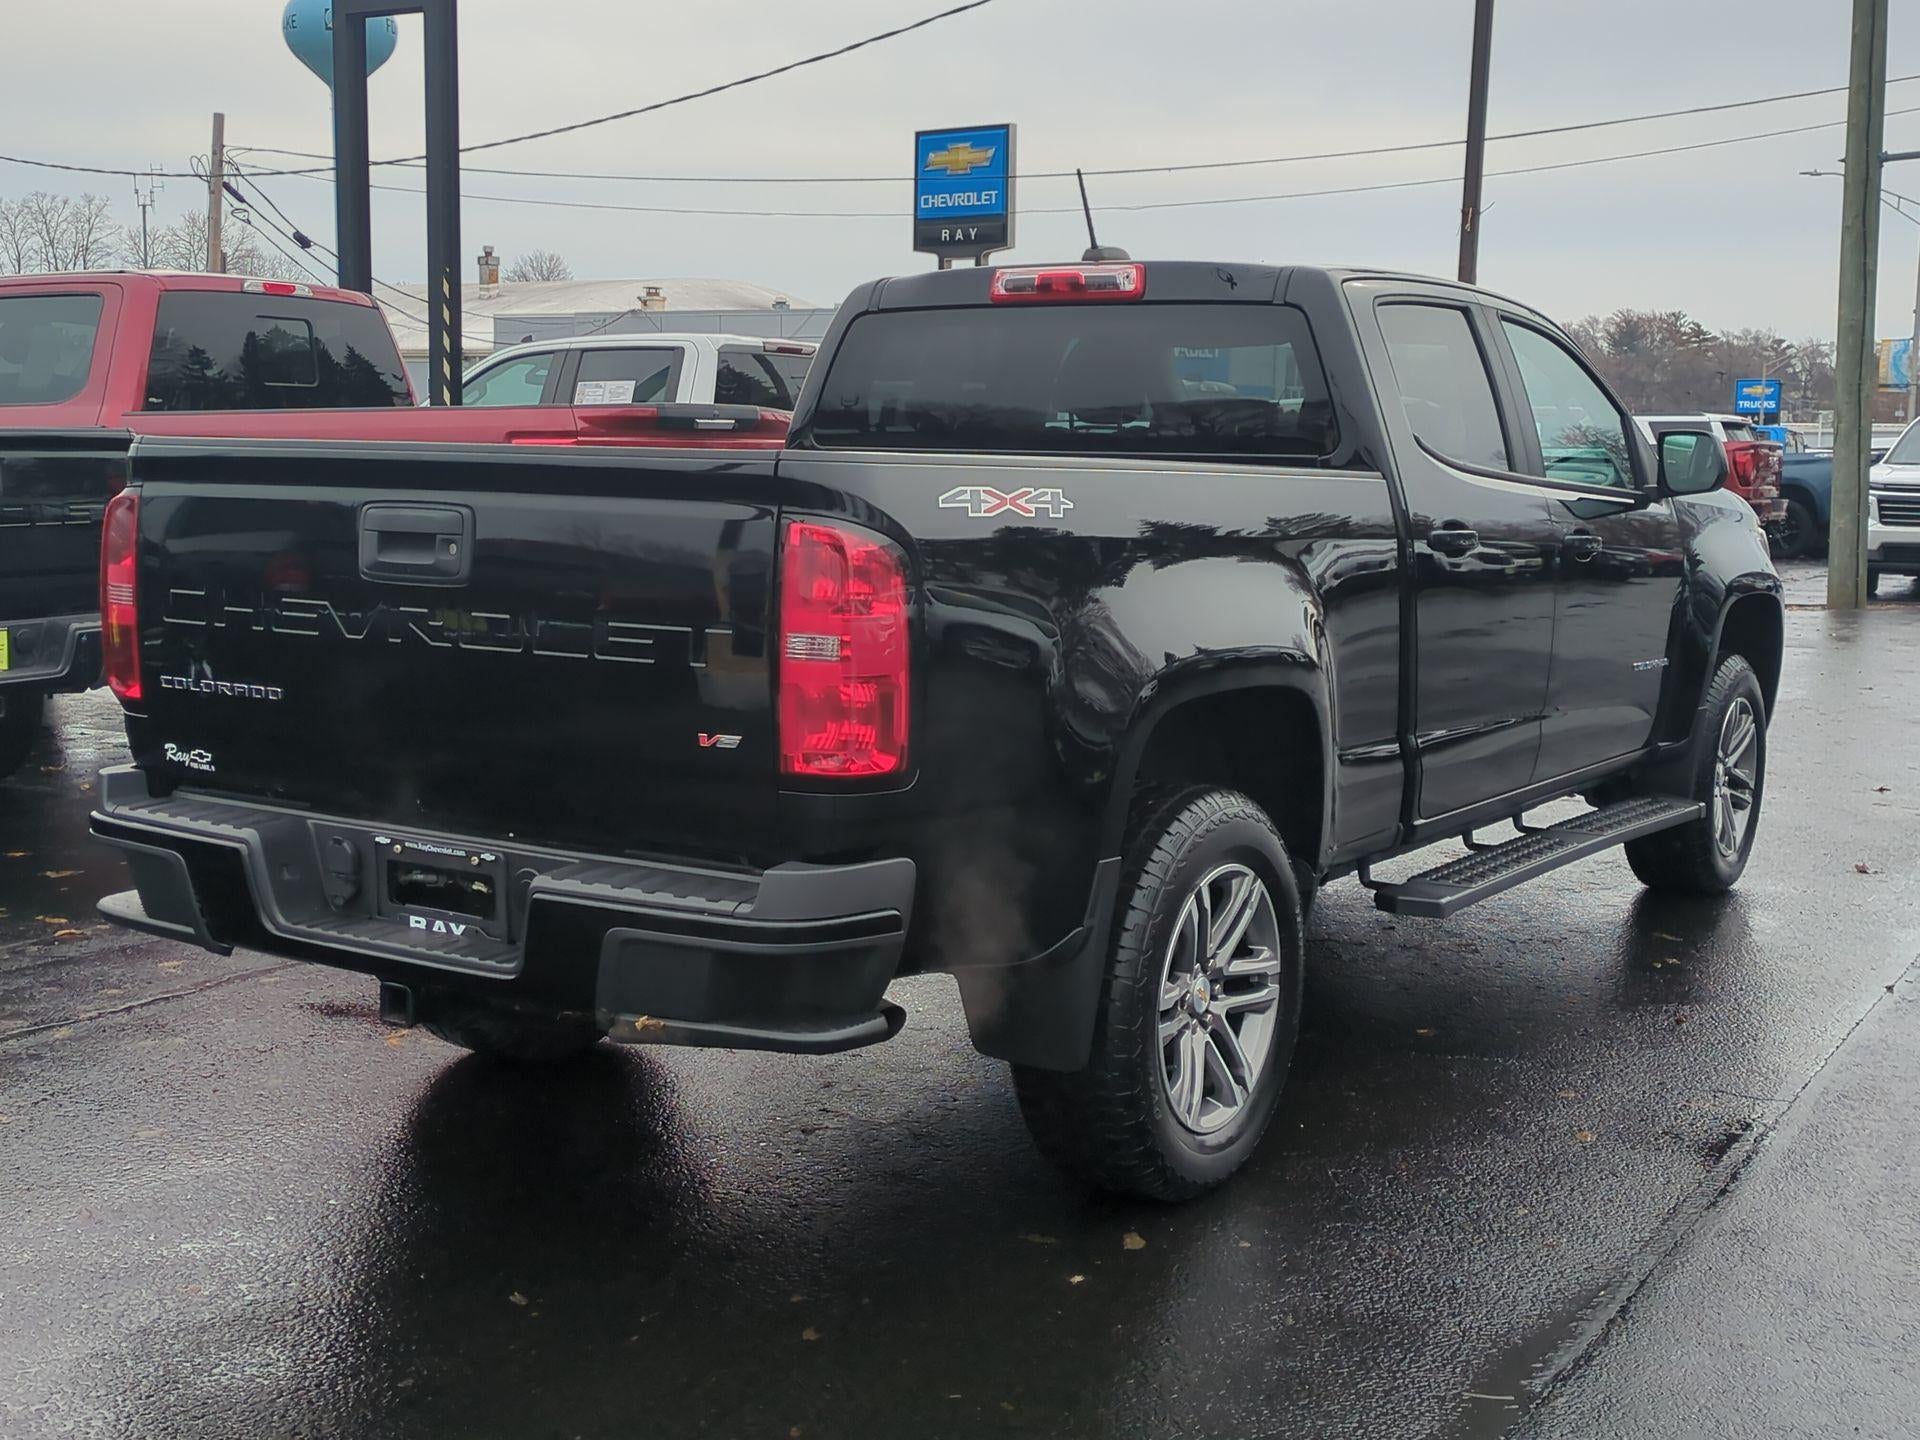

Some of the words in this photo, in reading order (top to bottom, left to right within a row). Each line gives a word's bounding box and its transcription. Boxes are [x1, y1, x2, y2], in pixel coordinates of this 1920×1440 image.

[920, 190, 998, 208] CHEVROLET
[941, 228, 978, 241] RAY
[1738, 400, 1776, 409] TRUCKS
[162, 587, 734, 668] CHEVROLET
[160, 675, 284, 700] COLORADO
[164, 743, 191, 767] Ray
